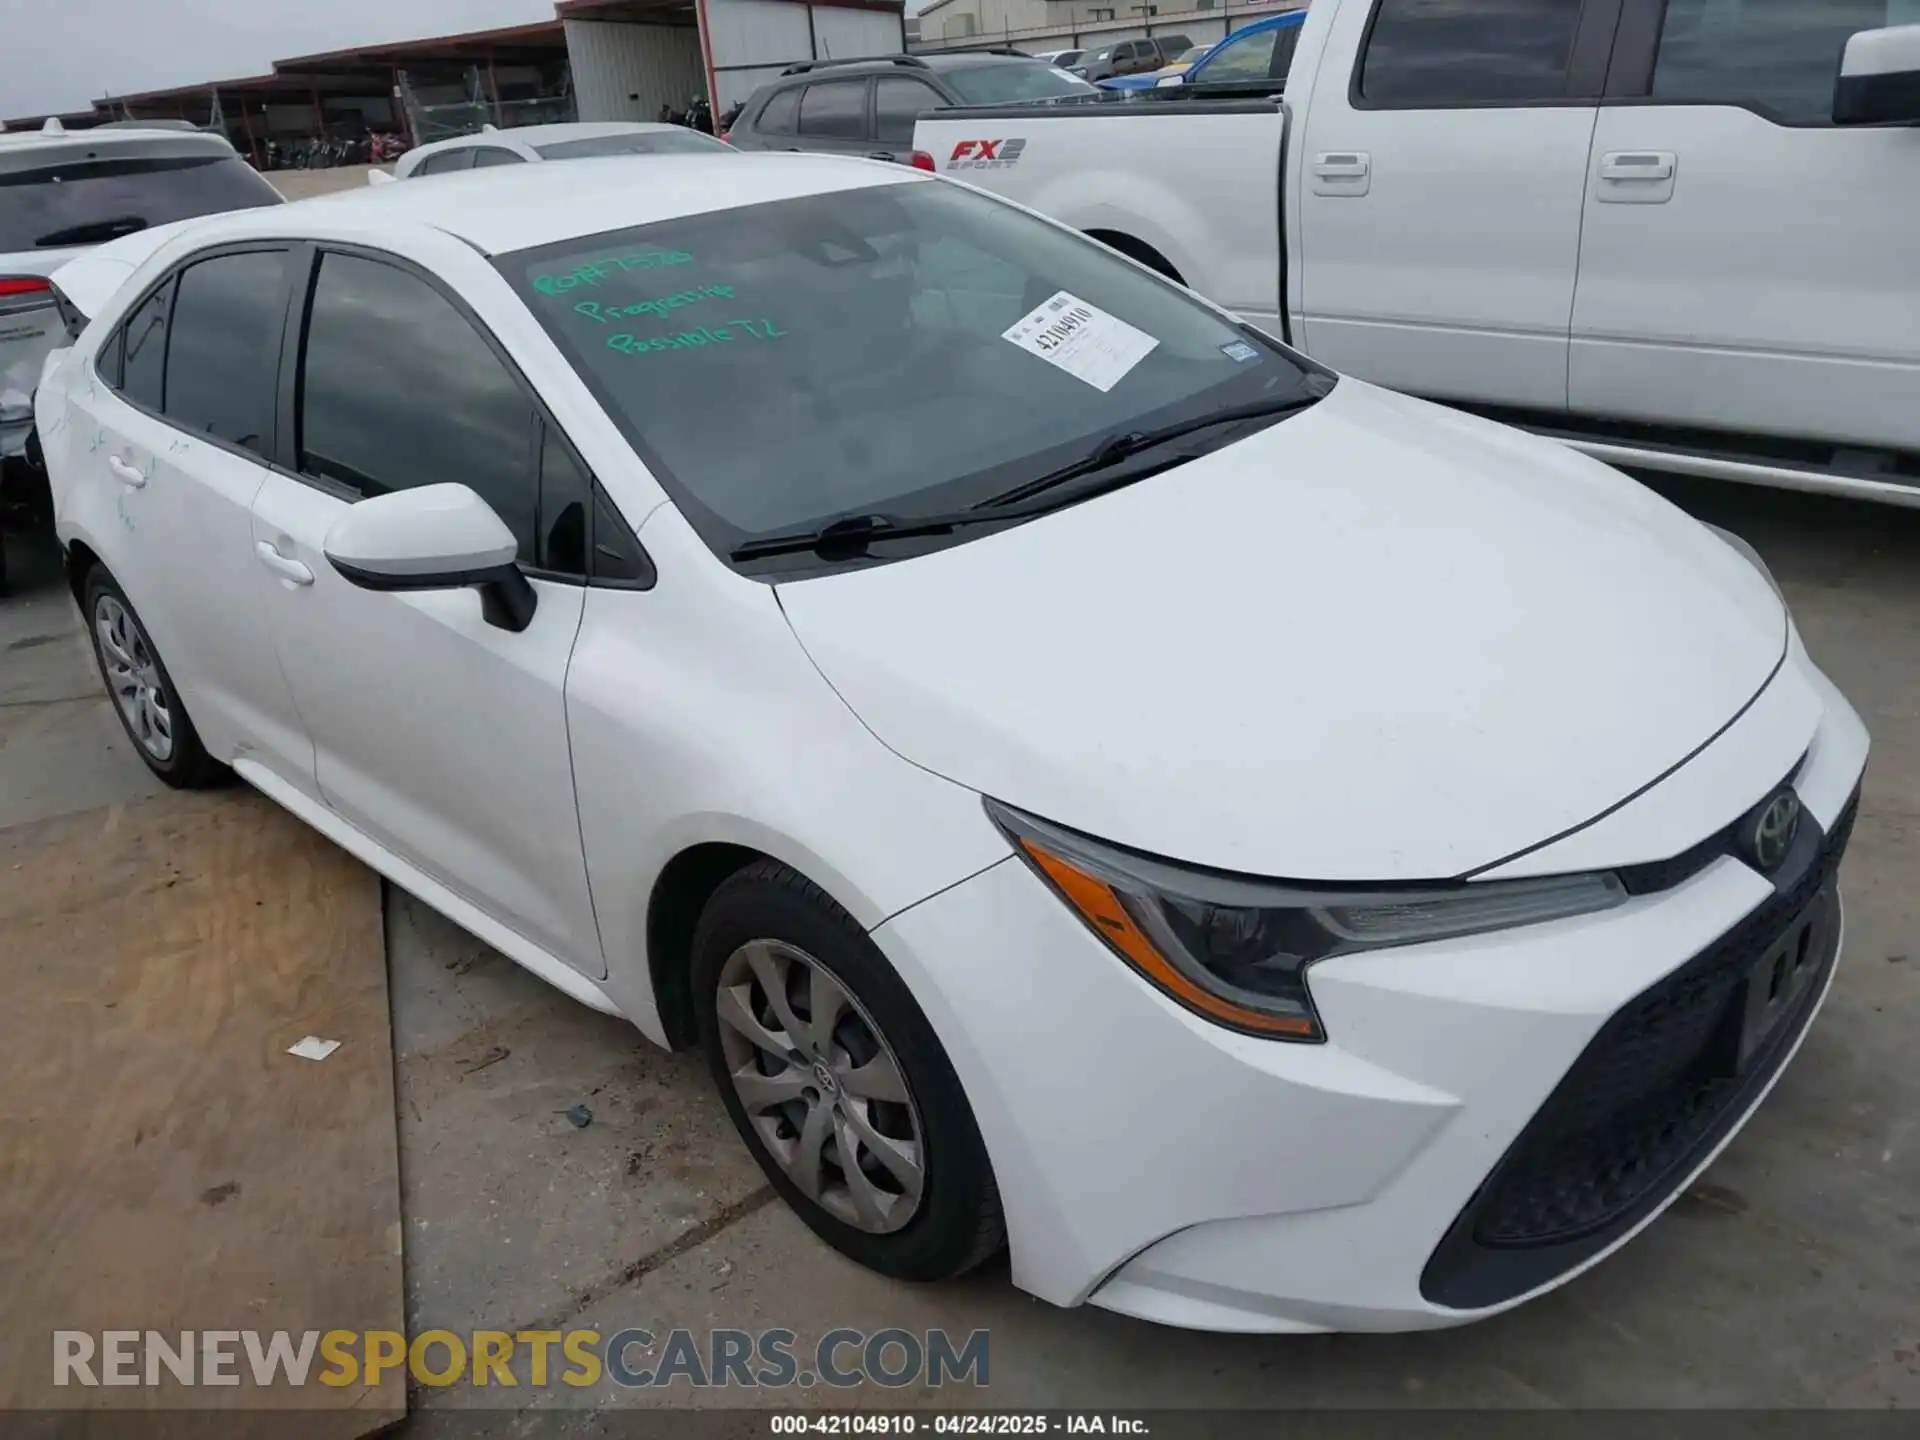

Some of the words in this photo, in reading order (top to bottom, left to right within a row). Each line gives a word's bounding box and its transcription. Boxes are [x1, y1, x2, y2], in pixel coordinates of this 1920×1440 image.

[949, 138, 1027, 161] FX2
[946, 160, 1018, 170] SPORT
[1035, 307, 1093, 351] 42104910
